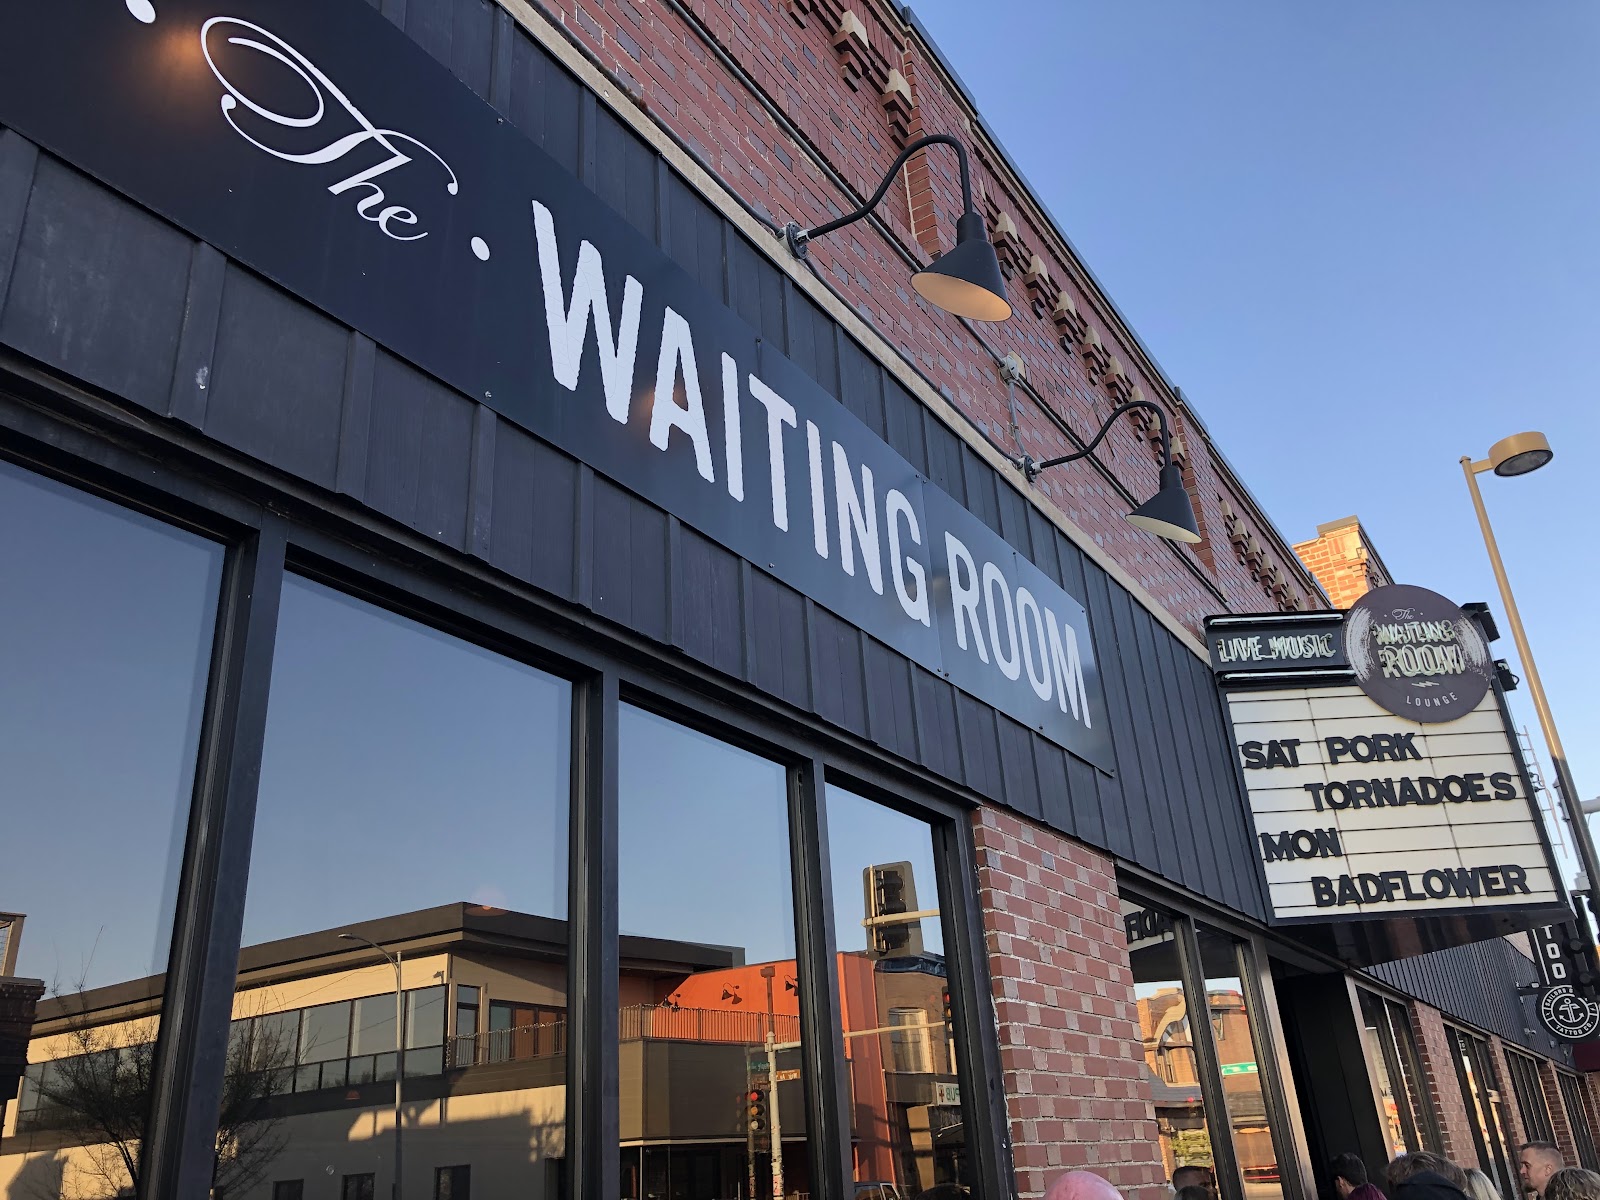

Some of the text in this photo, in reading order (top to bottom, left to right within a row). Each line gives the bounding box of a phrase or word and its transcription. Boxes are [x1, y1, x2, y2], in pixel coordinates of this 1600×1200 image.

[201, 17, 458, 240] The
[532, 200, 1092, 730] WAITING ROOM
[1391, 607, 1416, 621] The
[1217, 633, 1337, 662] LIVE MUSIC
[1373, 619, 1455, 645] WAITING
[1378, 643, 1466, 678] ROOM
[1406, 691, 1458, 707] LOUNGE
[1241, 732, 1423, 769] SAT PORK
[1304, 772, 1517, 812] TORNADOES
[1260, 827, 1342, 862] MON
[1311, 864, 1531, 907] BADFLOWER
[1544, 987, 1567, 1008] SAILORS
[1555, 1024, 1583, 1036] TATTOO
